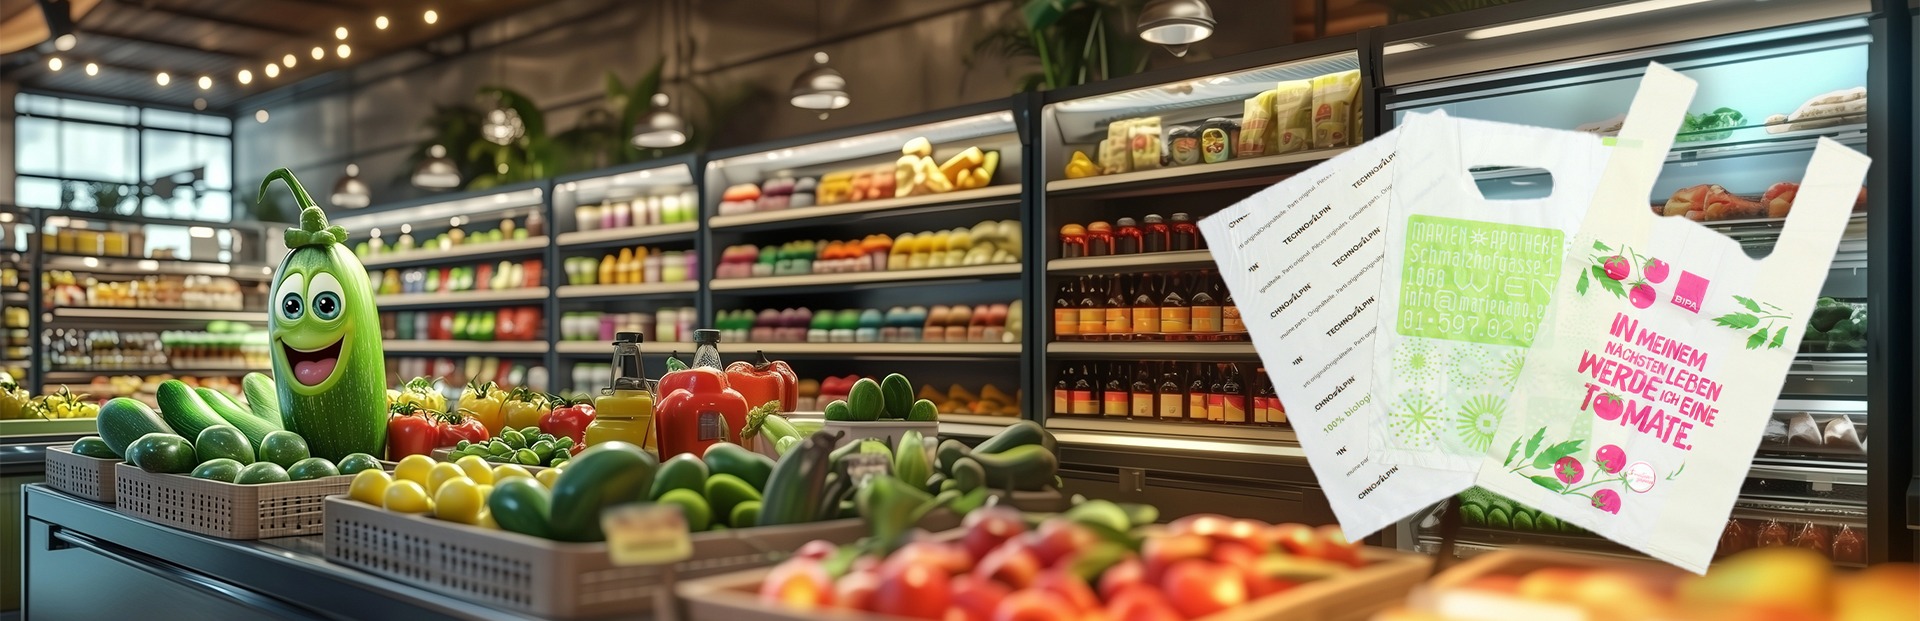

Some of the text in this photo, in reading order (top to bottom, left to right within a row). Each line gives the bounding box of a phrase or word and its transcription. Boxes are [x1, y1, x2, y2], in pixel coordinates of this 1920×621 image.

[1299, 186, 1316, 201] original
[1282, 264, 1293, 275] Parti
[1294, 250, 1310, 266] original
[1348, 204, 1368, 221] Genuine
[1368, 195, 1380, 207] parts
[1412, 222, 1558, 256] MARIEN APOTHEKE
[1410, 243, 1556, 277] Schmalzhofgasse 1
[1406, 267, 1554, 298] 1060 WIEN
[1270, 283, 1312, 319] CHNOALPIN
[1295, 317, 1307, 329] parts
[1336, 284, 1347, 295] Parti
[1675, 295, 1697, 310] BIPA
[1354, 337, 1365, 347] Parti
[1609, 312, 1708, 372] IN MEINEM
[1578, 349, 1719, 427] WERDE ICH EINE
[1604, 341, 1722, 402] NÄCHSTEN LEBEN
[1314, 376, 1355, 412] CHNOALPIN
[1323, 392, 1372, 434] 100% biologi
